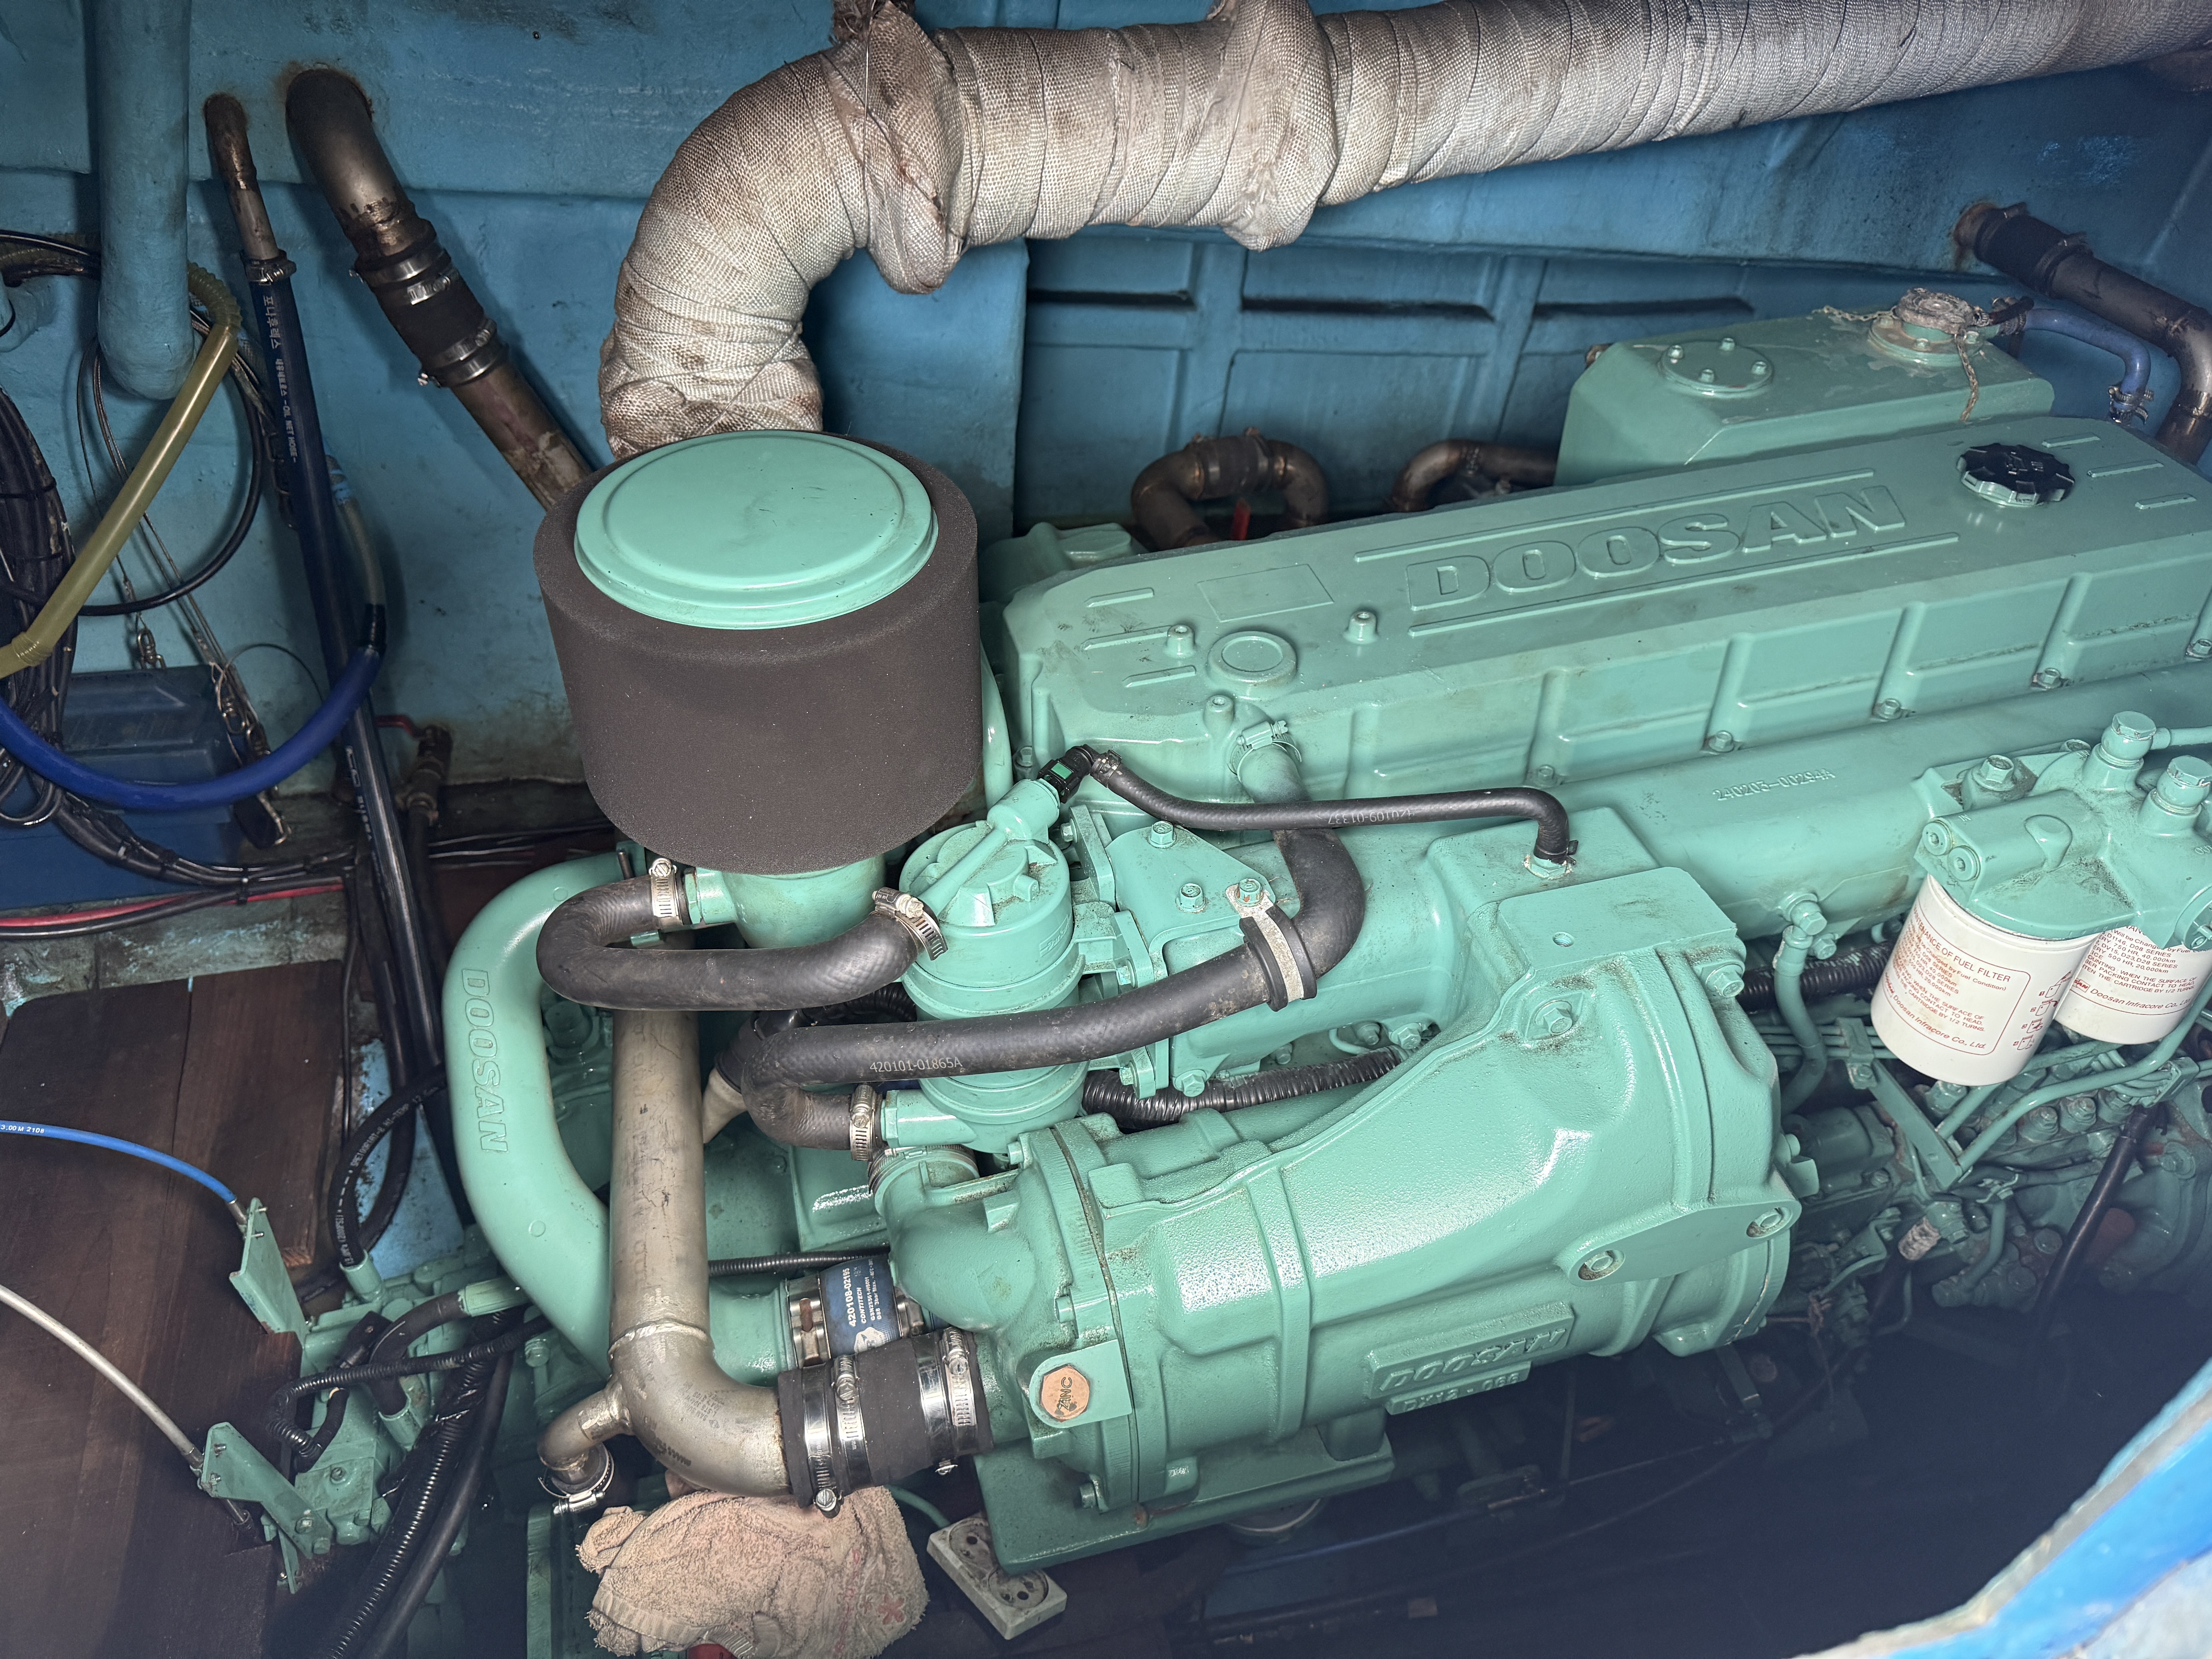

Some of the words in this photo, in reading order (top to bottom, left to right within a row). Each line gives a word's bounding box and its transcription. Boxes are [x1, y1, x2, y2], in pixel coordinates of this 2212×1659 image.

[285, 420, 294, 435] NET
[1407, 485, 1906, 611] DOOSAN
[1713, 769, 1835, 801] 240203-00294A
[2108, 953, 2121, 962] 500
[2114, 943, 2126, 951] 750
[2130, 943, 2143, 951] D08
[2146, 949, 2172, 957] SERIES
[1926, 948, 1948, 967] Changed
[1957, 970, 1971, 980] Fuel
[1973, 978, 2006, 991] Condition)
[1932, 962, 1953, 978] SERIES
[1942, 948, 1953, 957] OF
[1953, 955, 1974, 971] FUEL
[1977, 967, 2011, 982] FILTER
[2120, 970, 2140, 979] WHEN
[1937, 979, 1959, 994] SERIES
[2099, 967, 2129, 982] PACKING
[2131, 979, 2165, 988] CONTACT
[2099, 973, 2111, 981] THE
[2114, 980, 2153, 993] CARTRIDGE
[1908, 989, 1938, 1014] CARTRIDGE
[1914, 980, 1927, 994] WHEN
[1929, 993, 1941, 1003] THE
[1942, 1001, 1973, 1017] SURFACE
[1920, 993, 1948, 1012] CONTACT
[2090, 989, 2125, 1005] Doosan
[2125, 1000, 2164, 1009] Infracore
[1893, 995, 1915, 1018] Doosan
[1915, 1017, 1950, 1039] Infracore
[1951, 1036, 1967, 1046] Co.,
[462, 969, 508, 1152] DOOSAN
[870, 1057, 963, 1072] 420101-01865A
[843, 1268, 856, 1327] 420108-02195
[856, 1287, 867, 1324] CONTITECH
[1380, 1329, 1566, 1391] DOOSAN
[1059, 1377, 1072, 1411] ZINC
